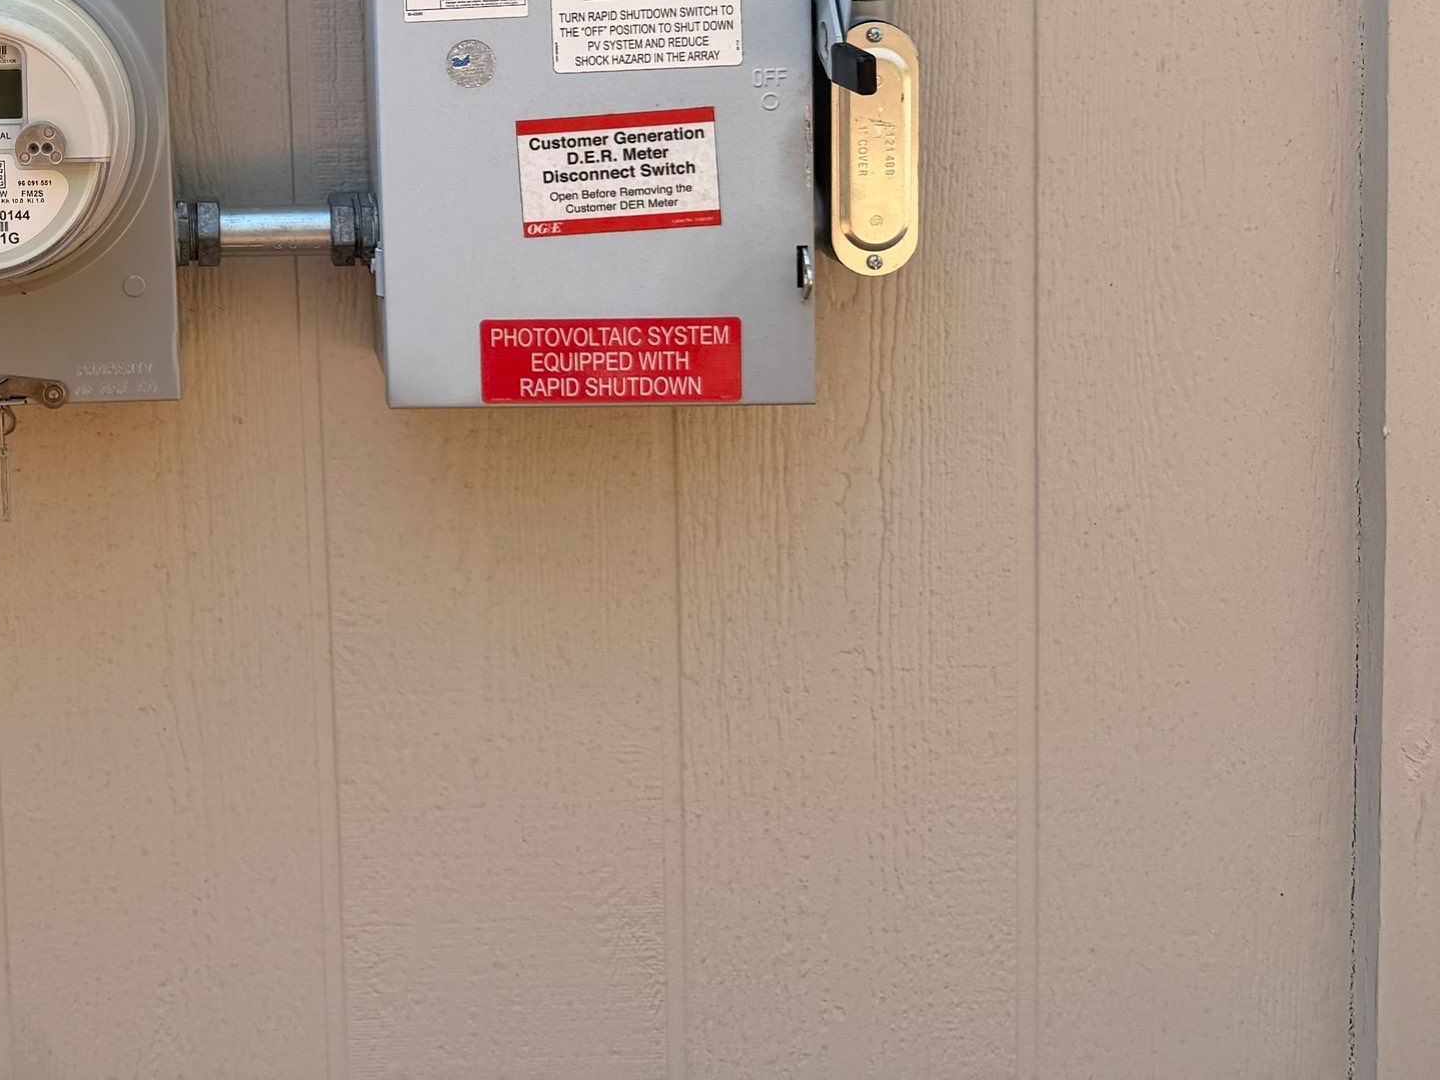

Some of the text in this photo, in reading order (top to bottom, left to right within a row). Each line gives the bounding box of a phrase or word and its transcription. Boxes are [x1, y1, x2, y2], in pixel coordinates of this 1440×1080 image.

[560, 5, 733, 22] TURN RAPID SHUTDOWN SWITCH TO
[560, 27, 579, 37] THE
[610, 24, 655, 35] POSITION
[659, 24, 671, 32] TO
[675, 22, 700, 32] SHUT
[703, 20, 733, 31] DOWN
[588, 36, 709, 50] PV SYSTEM AND REDUCE
[575, 50, 720, 66] SHOCK HAZARD IN THE ARRAY
[752, 68, 787, 88] OFF
[529, 127, 704, 150] Customer Generation
[567, 147, 669, 165] D.E.R. Meter
[543, 162, 695, 183] Disconnect Switch
[550, 184, 692, 203] Open Before Removing the
[566, 198, 678, 213] Customer DER Meter
[527, 223, 562, 235] OG&E
[491, 326, 729, 347] PHOTOVOLTAIC SYSTEM
[531, 352, 689, 372] EQUIPPED WITH
[520, 377, 702, 396] RAPID SHUTDOWN
